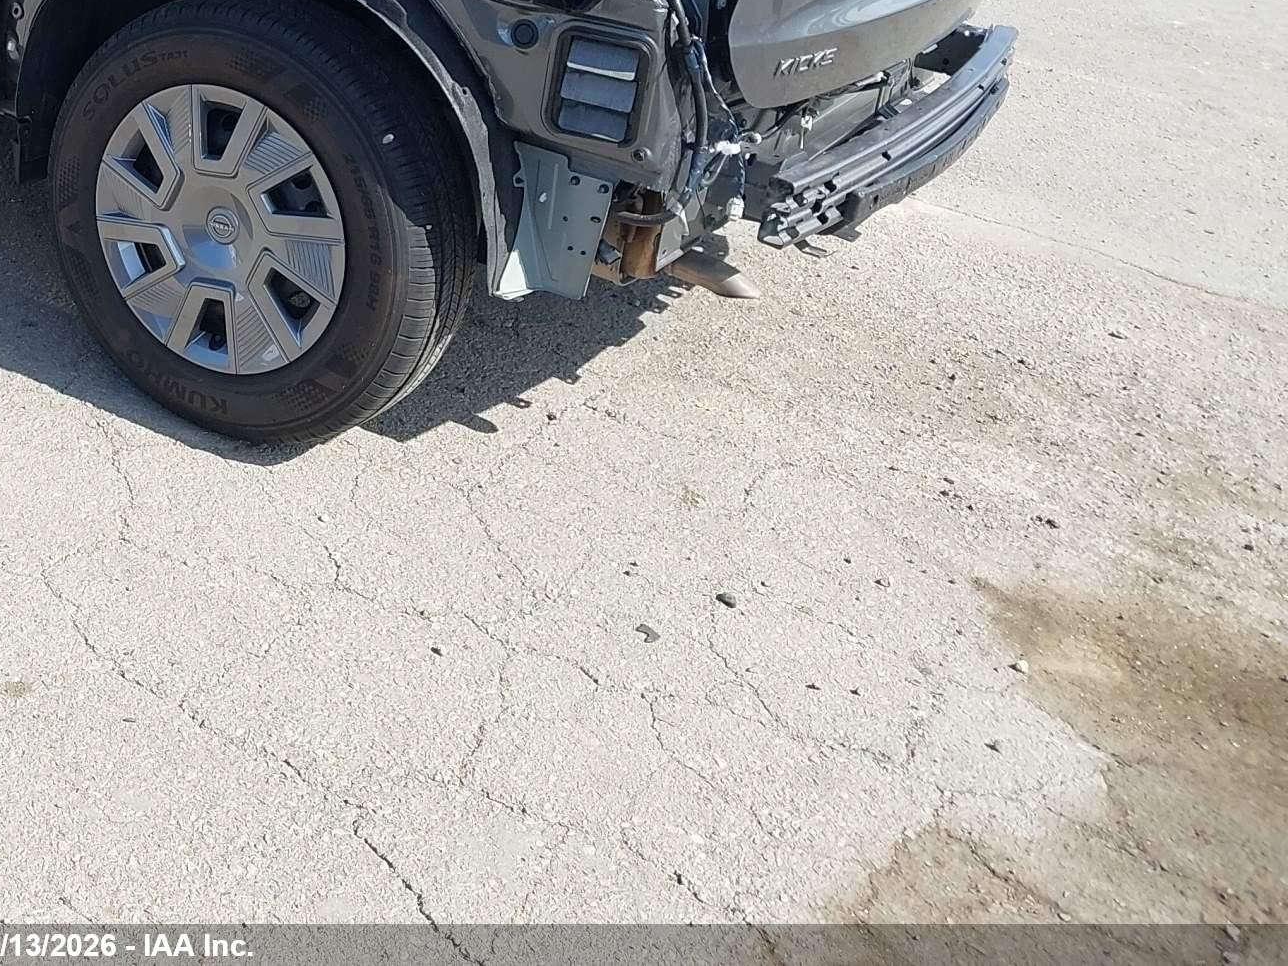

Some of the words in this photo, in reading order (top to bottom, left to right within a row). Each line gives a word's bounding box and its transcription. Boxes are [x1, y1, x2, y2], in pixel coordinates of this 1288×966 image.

[82, 50, 159, 121] SOLUS
[773, 46, 839, 79] KICKS
[126, 349, 229, 415] KUMHO
